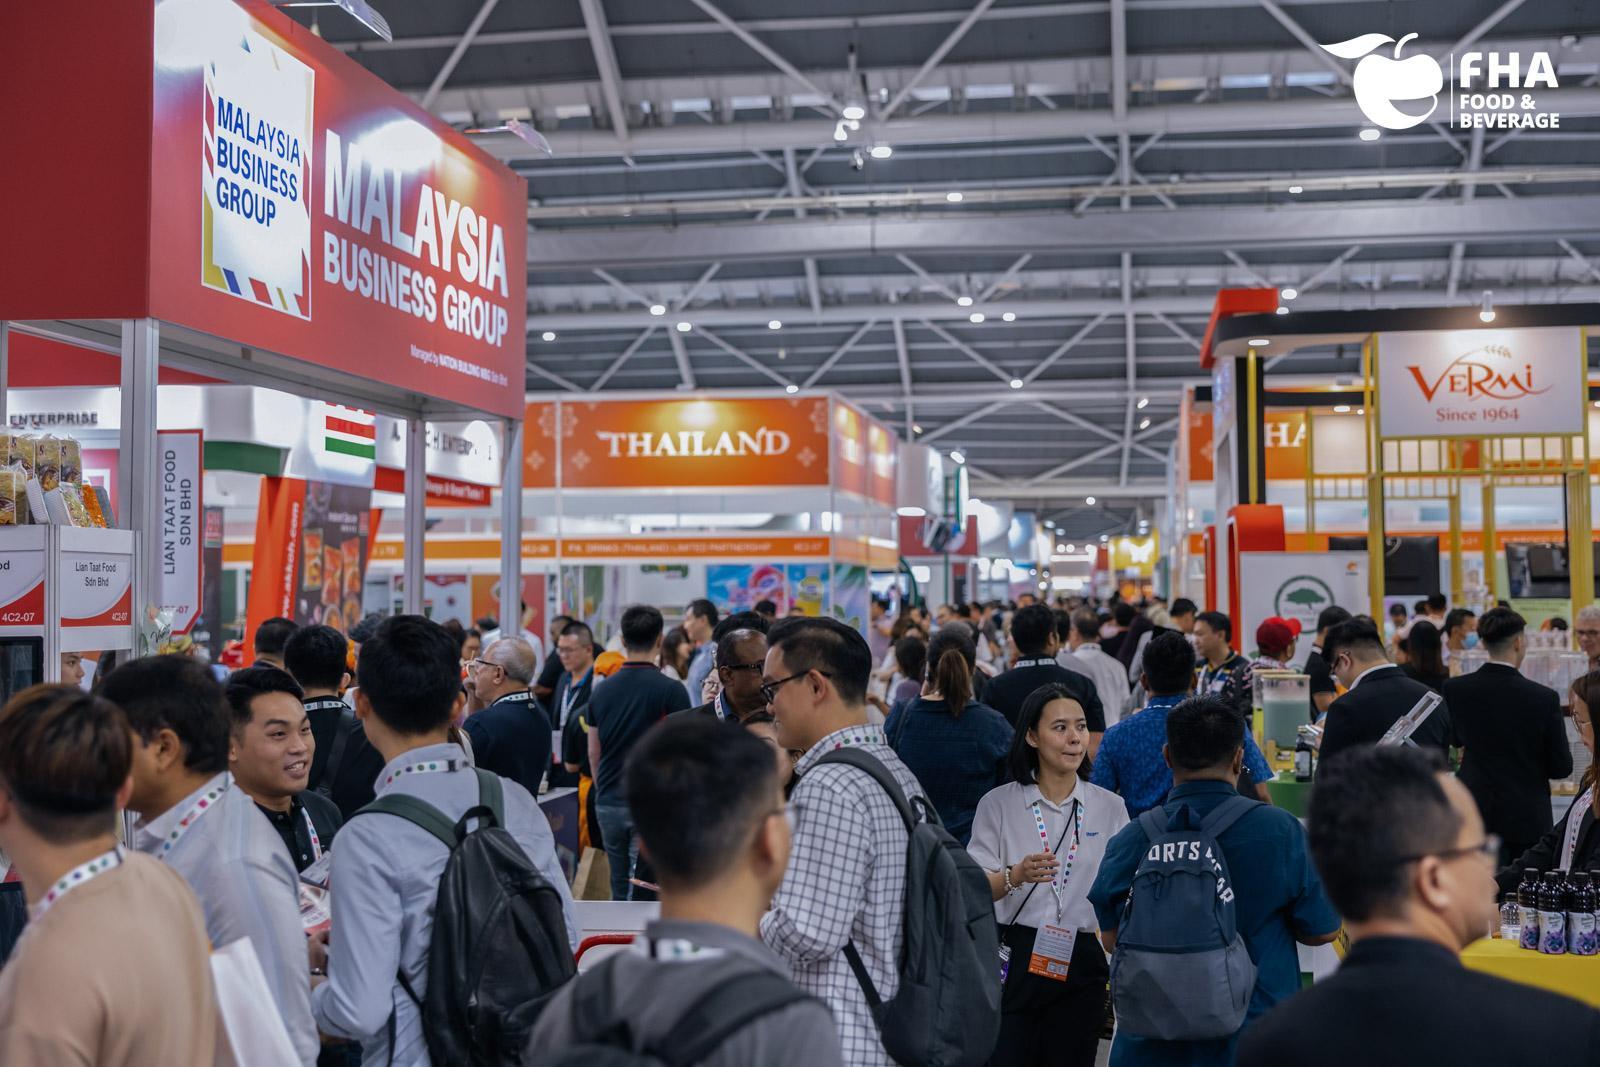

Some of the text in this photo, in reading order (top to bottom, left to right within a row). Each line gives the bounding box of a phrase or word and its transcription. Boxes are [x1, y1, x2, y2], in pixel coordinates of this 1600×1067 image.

[218, 96, 300, 167] MALAYSIA
[217, 136, 298, 202] BUSINESS
[216, 177, 275, 227] GROUP
[324, 128, 509, 298] MALAYSIA
[324, 230, 508, 347] BUSINESS GROUP
[10, 412, 98, 425] ENTERPRISE
[1436, 407, 1519, 422] Since 1964
[596, 426, 791, 457] THAILAND
[164, 449, 176, 575] LIAN TAAT FOOD
[181, 478, 191, 546] SDN BHD
[75, 562, 116, 573] Lian Taat Food
[85, 577, 109, 587] Sdn Bhd
[2, 613, 35, 622] 4C2-07
